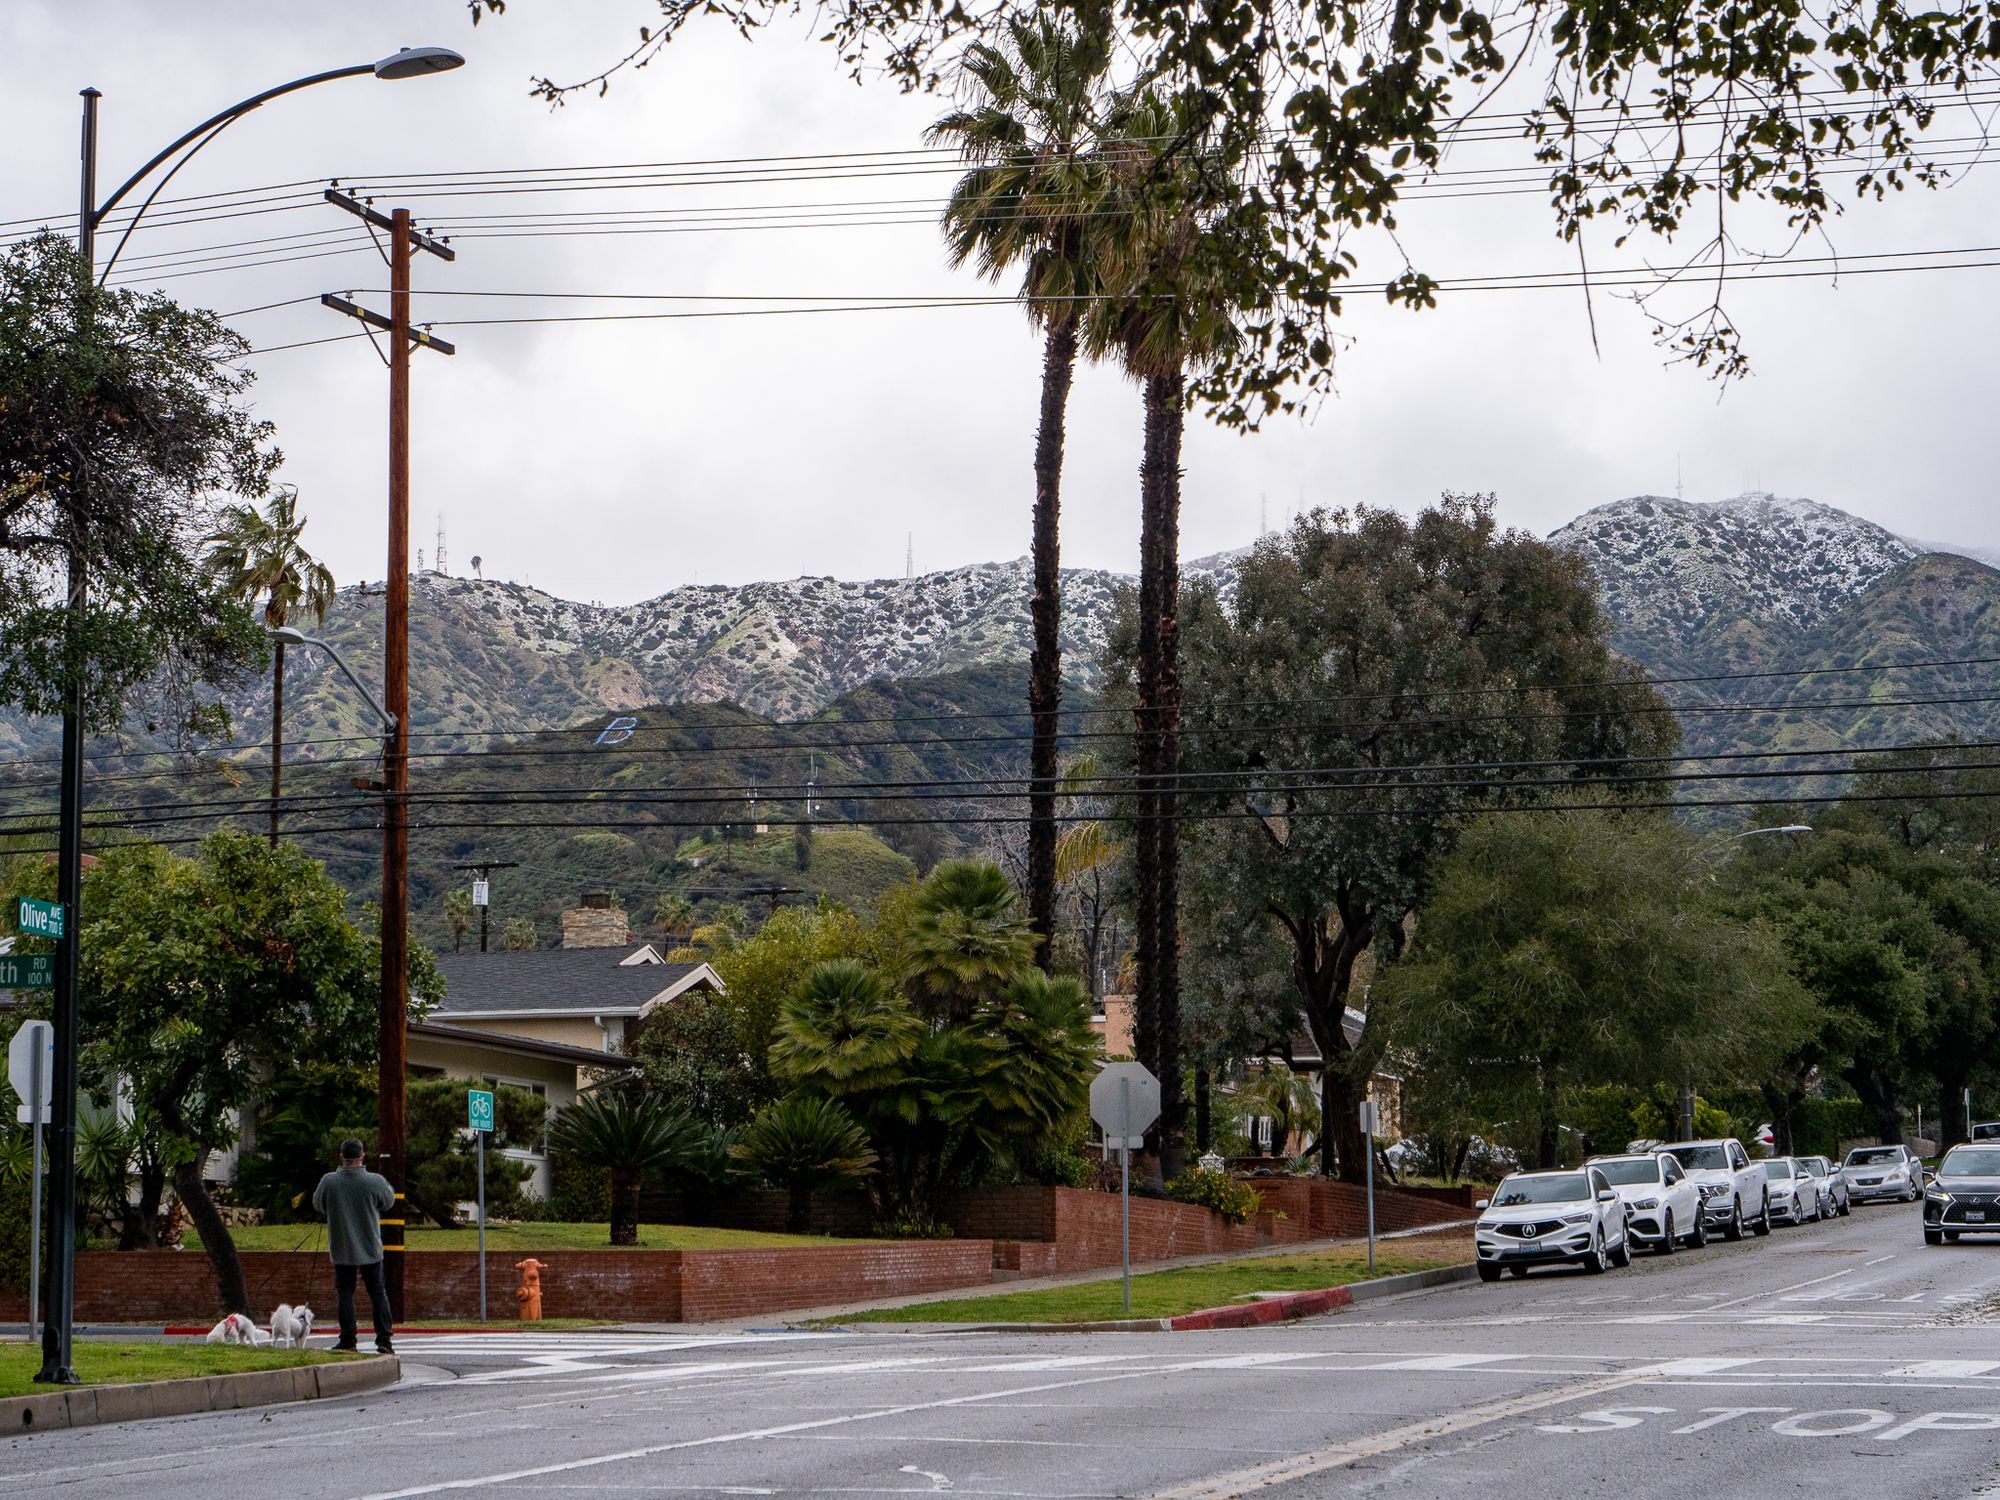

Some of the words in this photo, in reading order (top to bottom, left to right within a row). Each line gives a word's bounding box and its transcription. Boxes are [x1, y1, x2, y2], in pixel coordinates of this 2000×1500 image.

[21, 902, 47, 930] Olive
[50, 907, 61, 920] AVE
[58, 923, 62, 935] E
[33, 957, 47, 970] RD
[27, 972, 42, 985] 100
[45, 972, 52, 984] N
[1534, 1406, 2000, 1441] STOP
